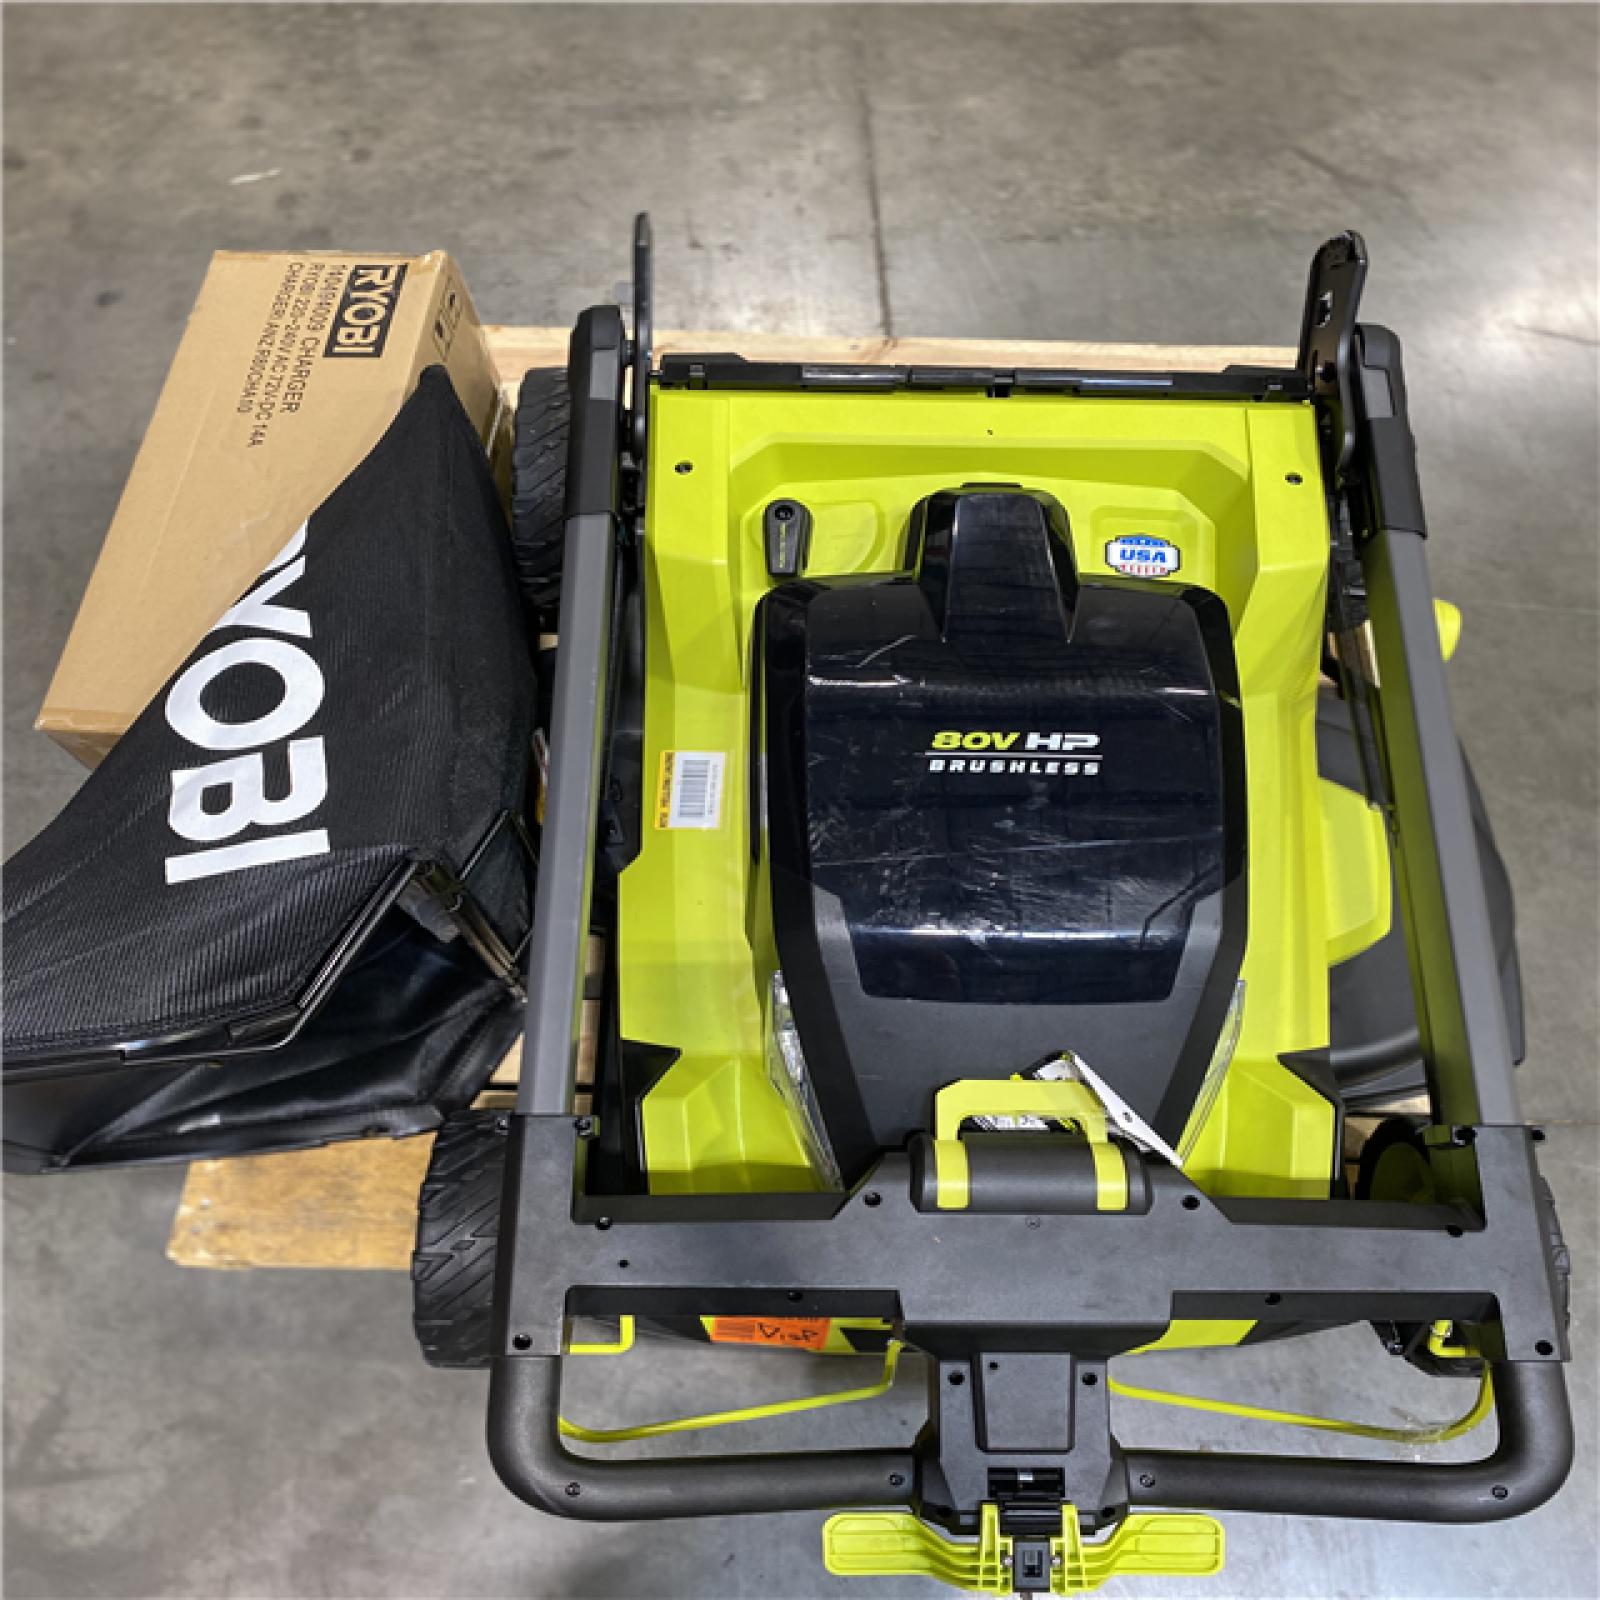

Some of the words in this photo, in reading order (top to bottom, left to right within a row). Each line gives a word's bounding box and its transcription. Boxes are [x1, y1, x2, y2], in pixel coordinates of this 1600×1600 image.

[332, 266, 397, 354] RYOBI
[279, 336, 320, 414] CHARGER
[1119, 549, 1166, 563] USA
[164, 518, 331, 884] YOBI
[931, 731, 1021, 750] 80V
[1024, 731, 1100, 751] HP
[929, 759, 1099, 776] BRUSHLESS
